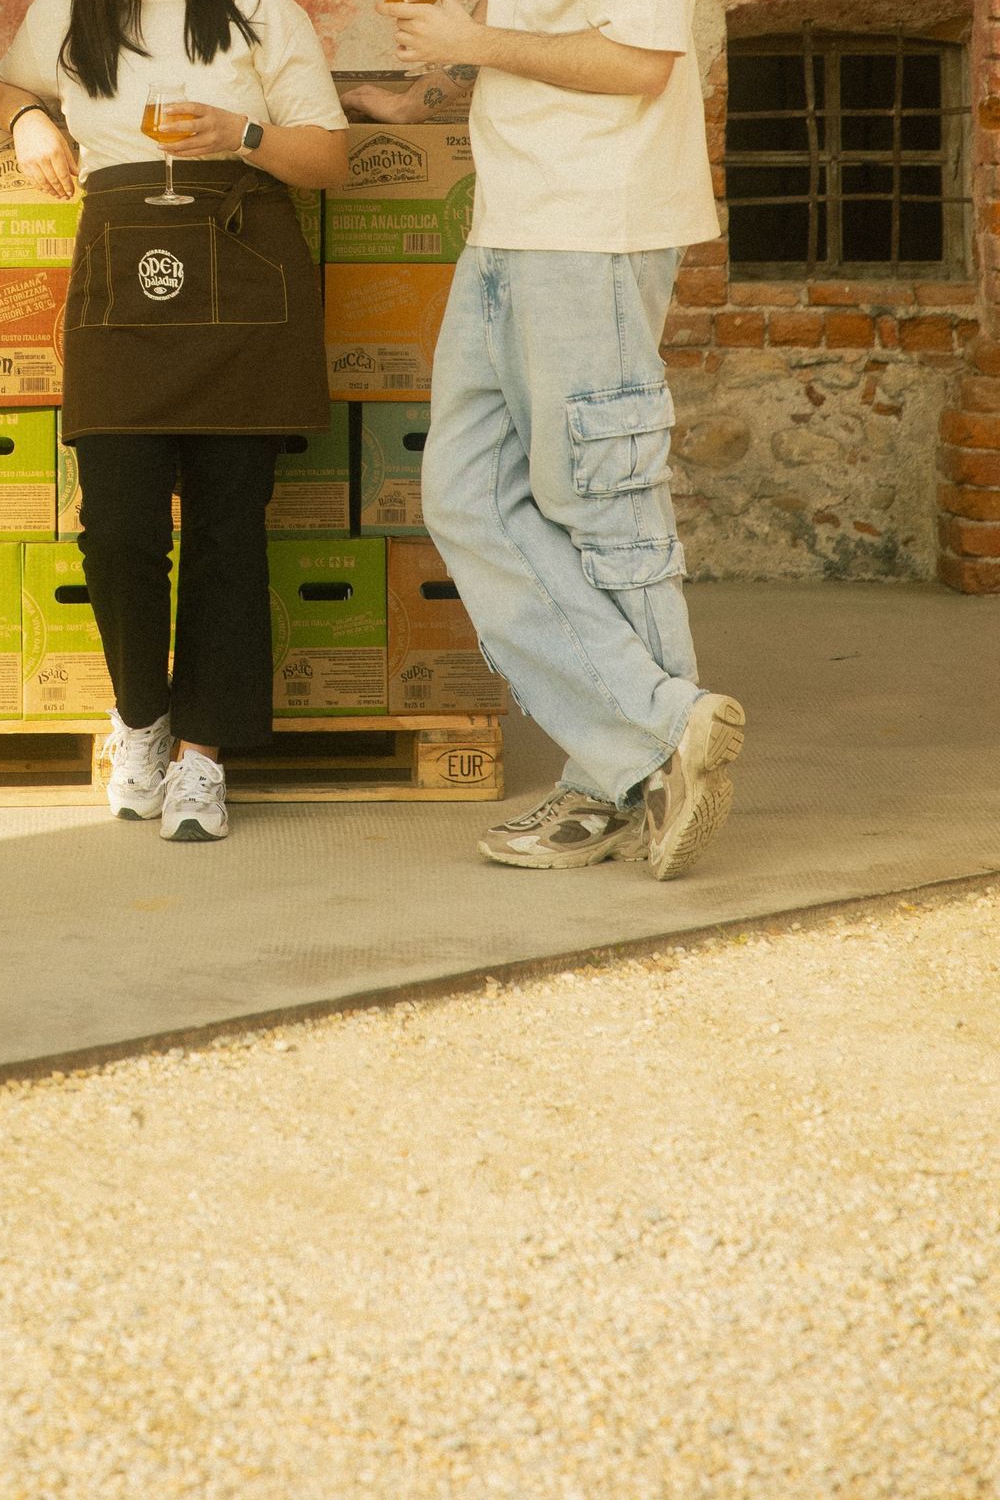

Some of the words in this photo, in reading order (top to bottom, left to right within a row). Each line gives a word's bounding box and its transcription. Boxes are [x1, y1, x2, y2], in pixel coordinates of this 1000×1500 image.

[10, 219, 57, 235] DRINK
[332, 214, 367, 229] BIBITA
[370, 213, 439, 229] ANALCOLICA
[1, 250, 10, 258] OF
[377, 244, 396, 253] ITALY
[3, 278, 42, 296] ITALIANA
[25, 305, 33, 314] A
[1, 334, 22, 342] GUSTO
[65, 459, 74, 484] SINCE
[33, 635, 41, 653] DAL
[448, 755, 484, 777] EUR
